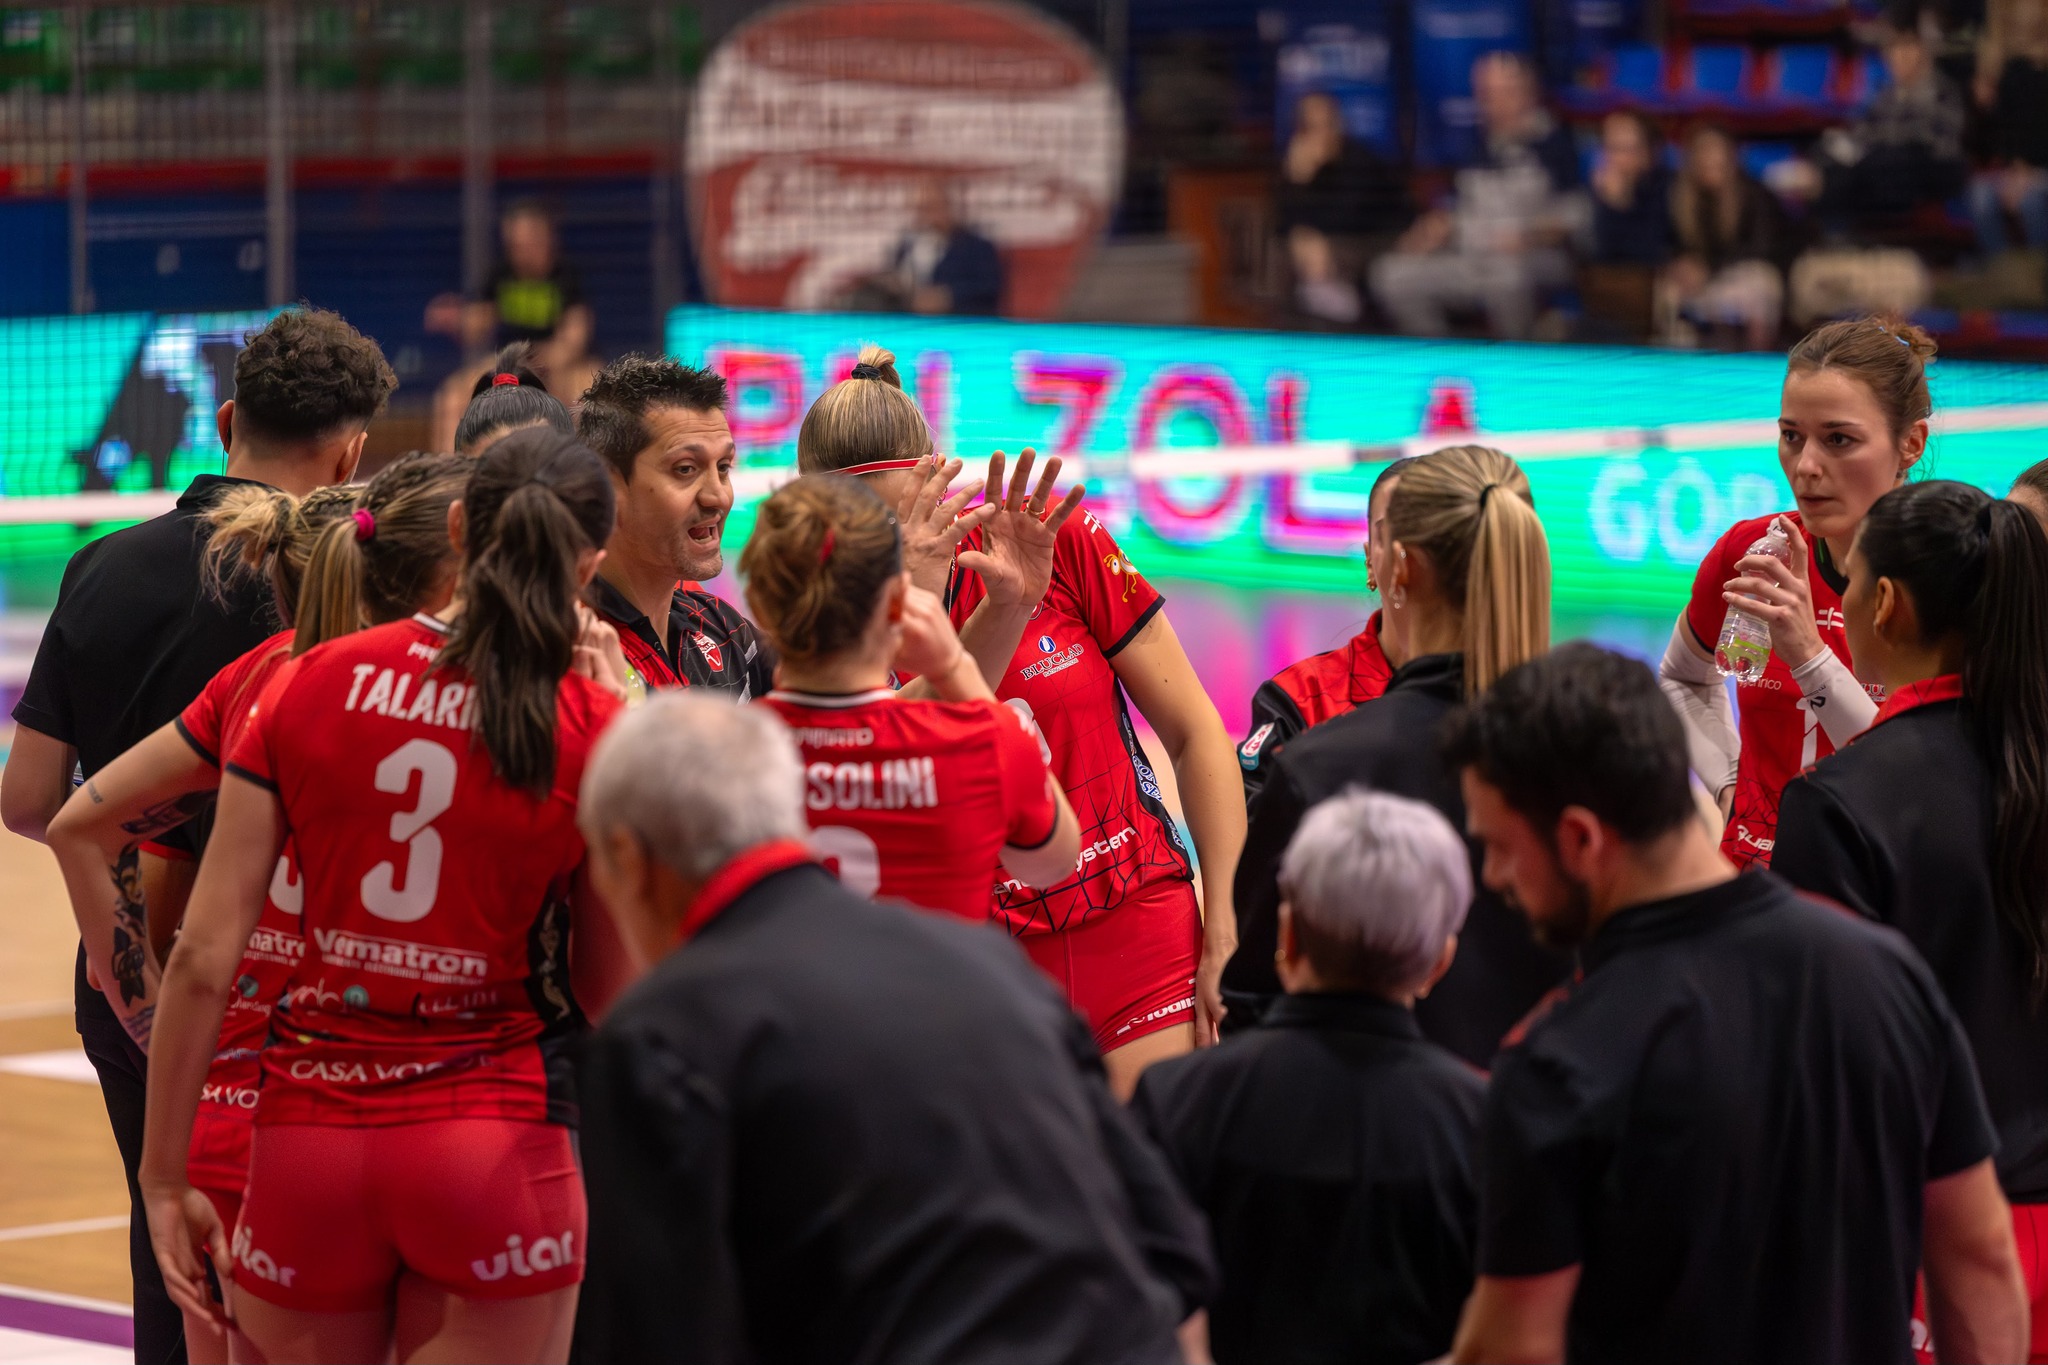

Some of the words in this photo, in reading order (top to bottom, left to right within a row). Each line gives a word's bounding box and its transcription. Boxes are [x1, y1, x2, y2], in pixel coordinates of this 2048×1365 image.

[1020, 643, 1085, 681] BLUCLAD
[345, 663, 482, 732] TALARI
[806, 756, 939, 811] SOLINI
[361, 737, 458, 922] 3
[1075, 826, 1137, 872] ystem
[290, 1058, 369, 1083] CASA
